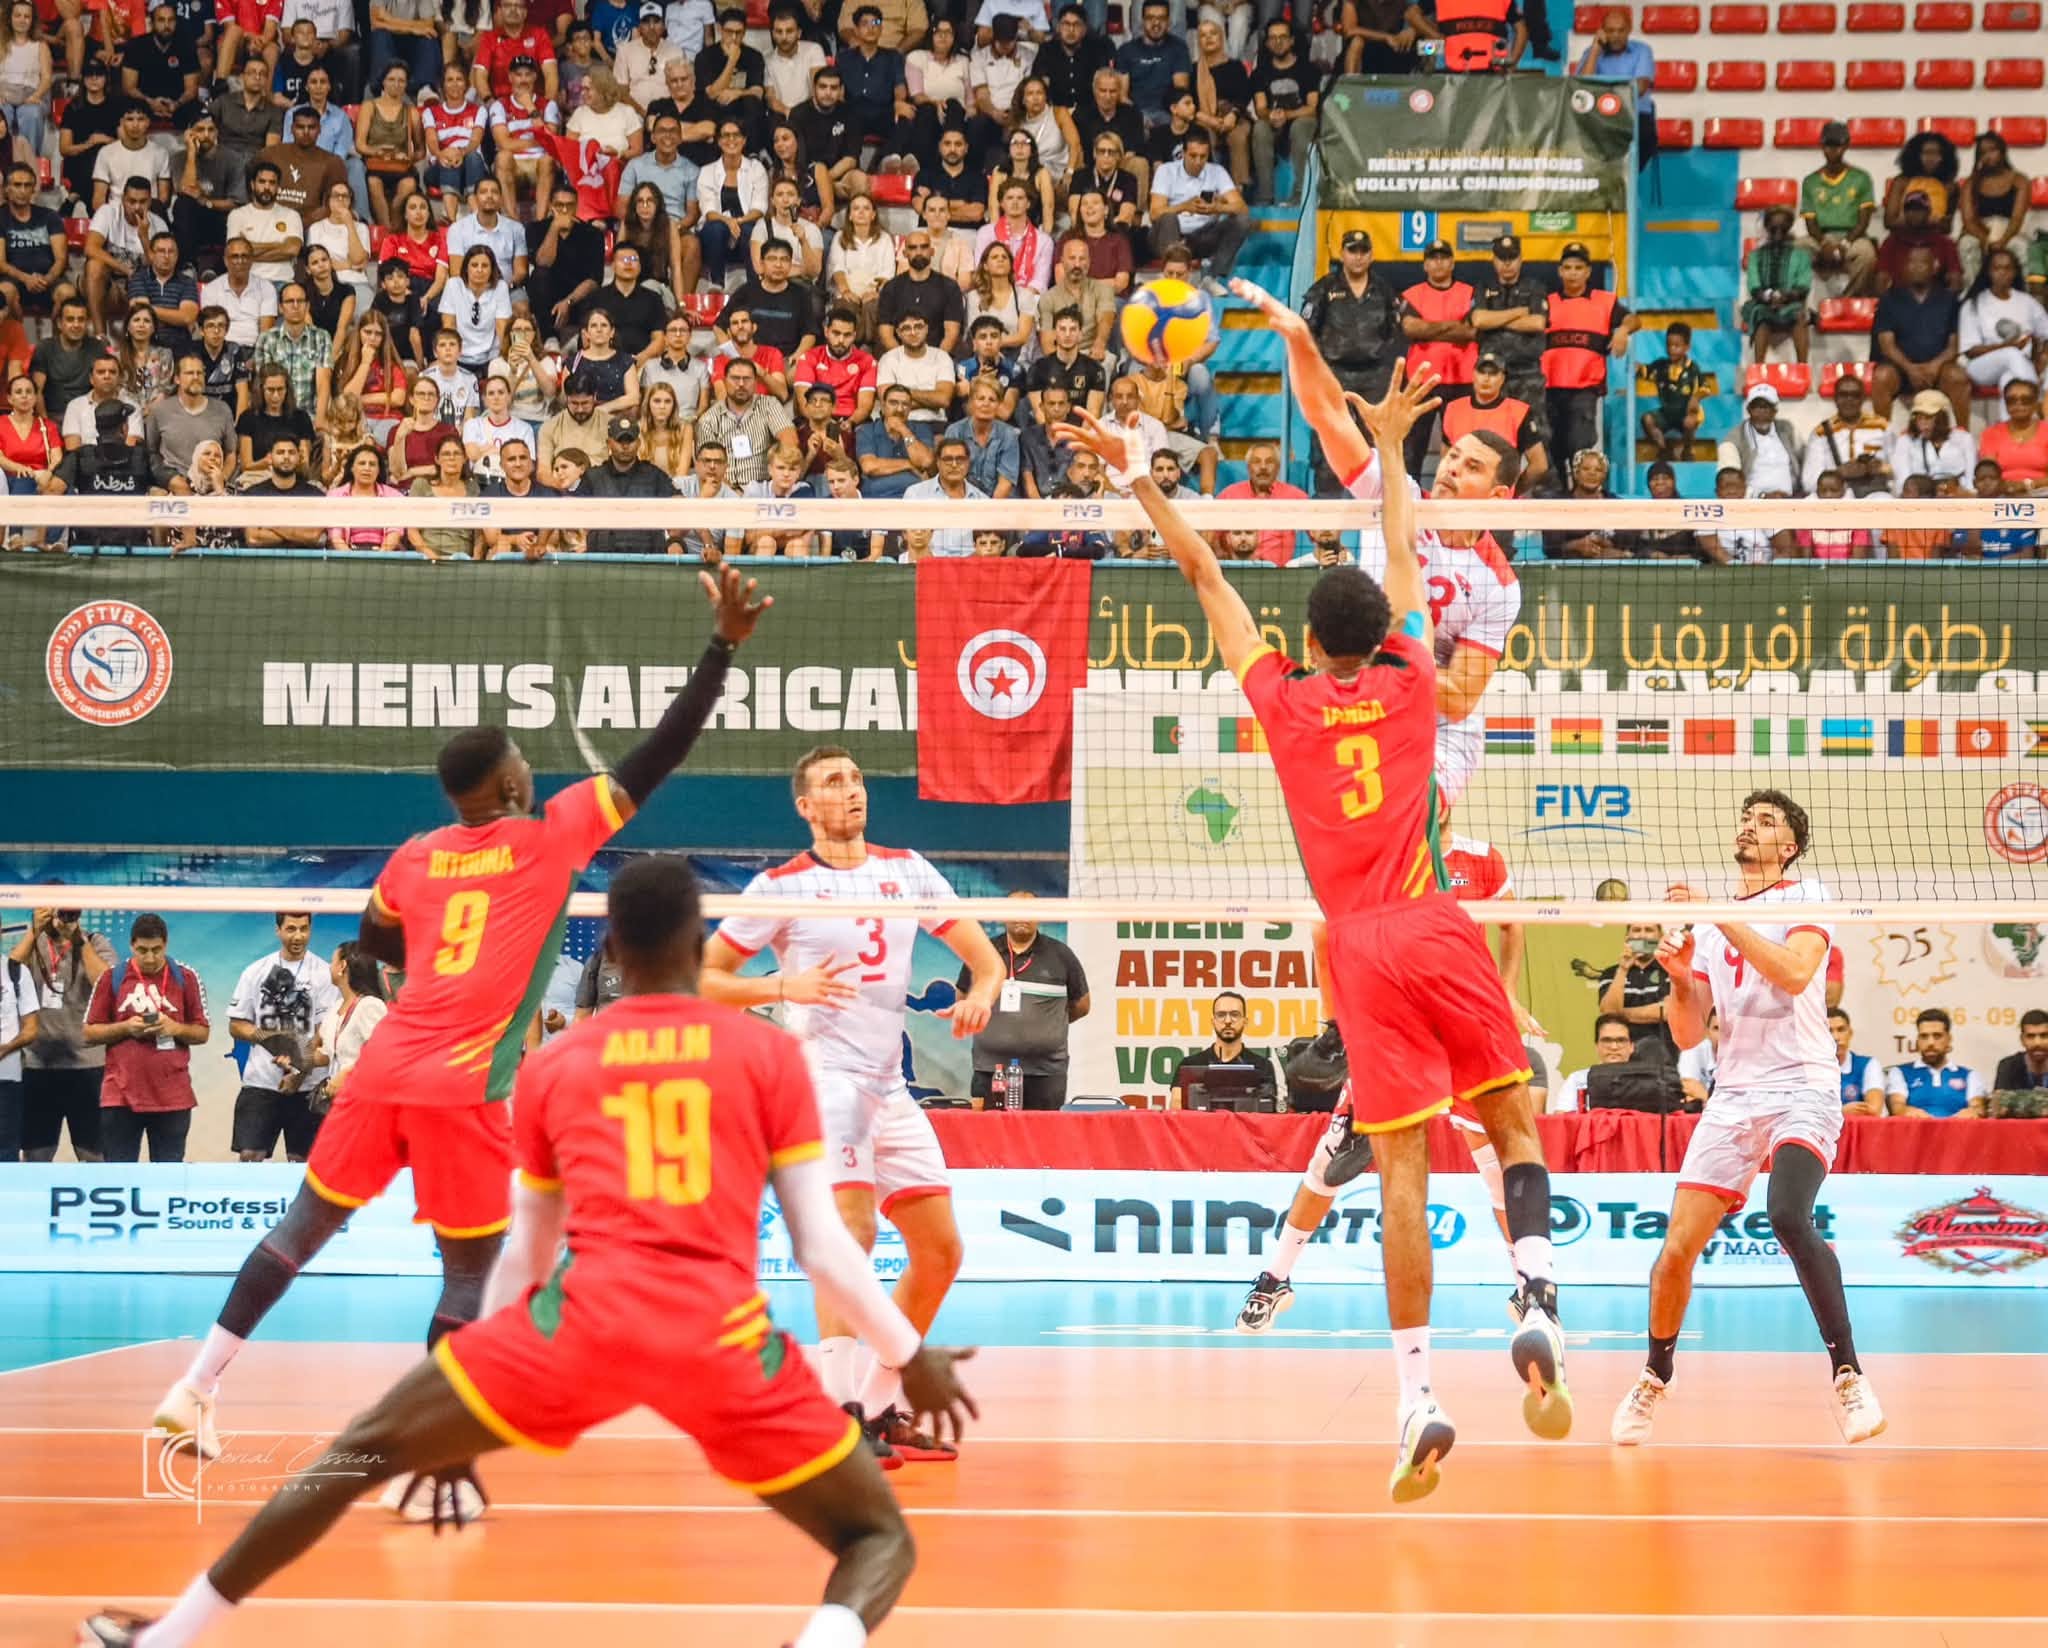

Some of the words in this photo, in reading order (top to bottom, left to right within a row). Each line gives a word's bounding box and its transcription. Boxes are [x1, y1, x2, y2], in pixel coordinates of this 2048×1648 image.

[1368, 158, 1425, 172] MEN'S
[1428, 157, 1505, 172] AFRICAN
[1508, 158, 1584, 172] NATIONS
[1356, 177, 1460, 192] VOLLEYBALL
[1463, 177, 1600, 192] CHAMPIONSHIP
[1411, 211, 1427, 245] 9
[451, 503, 491, 515] FIVB
[757, 503, 797, 516] FIVB
[1063, 503, 1103, 516] FIVB
[1683, 504, 1724, 518] FIVB
[1994, 503, 2035, 517] FIVB
[85, 607, 135, 625] FTVB
[263, 662, 557, 729] MEN'S
[577, 665, 918, 731] AFRICA
[1335, 734, 1384, 820] 3
[1535, 784, 1632, 818] FIVB
[433, 889, 491, 976] 9
[855, 917, 887, 967] 3
[1888, 927, 1932, 967] 25
[1116, 950, 1321, 988] AFRICA
[601, 1077, 713, 1207] 19
[842, 1146, 858, 1169] 3
[50, 1187, 160, 1217] PSL
[168, 1197, 287, 1214] Professi
[168, 1217, 233, 1230] Sound
[241, 1217, 256, 1230] &
